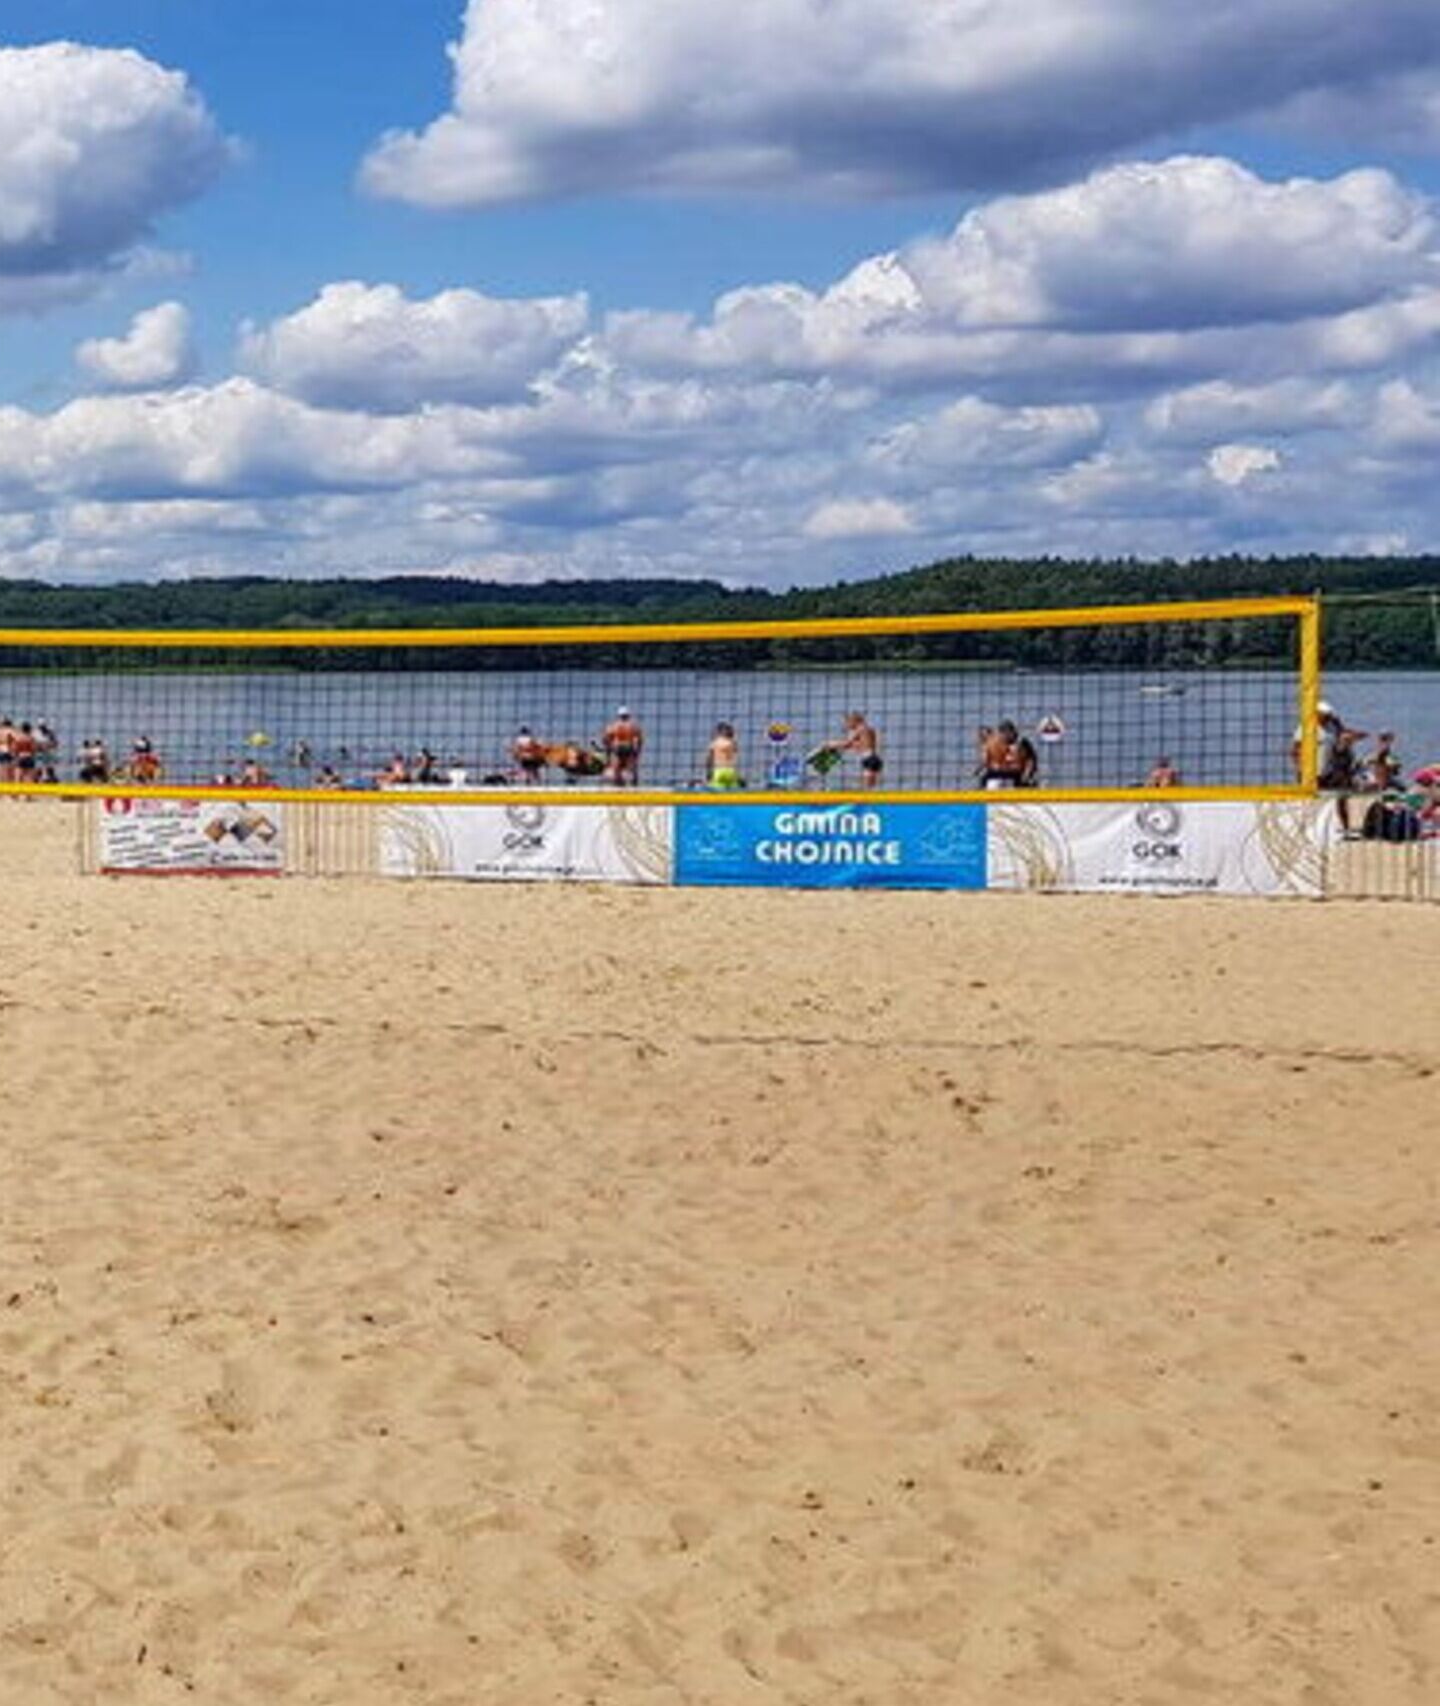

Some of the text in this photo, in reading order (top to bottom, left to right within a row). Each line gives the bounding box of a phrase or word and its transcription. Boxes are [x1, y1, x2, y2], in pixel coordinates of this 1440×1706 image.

[774, 812, 881, 834] GMINA
[755, 840, 901, 864] CHOJNICE
[1132, 841, 1181, 859] GOK
